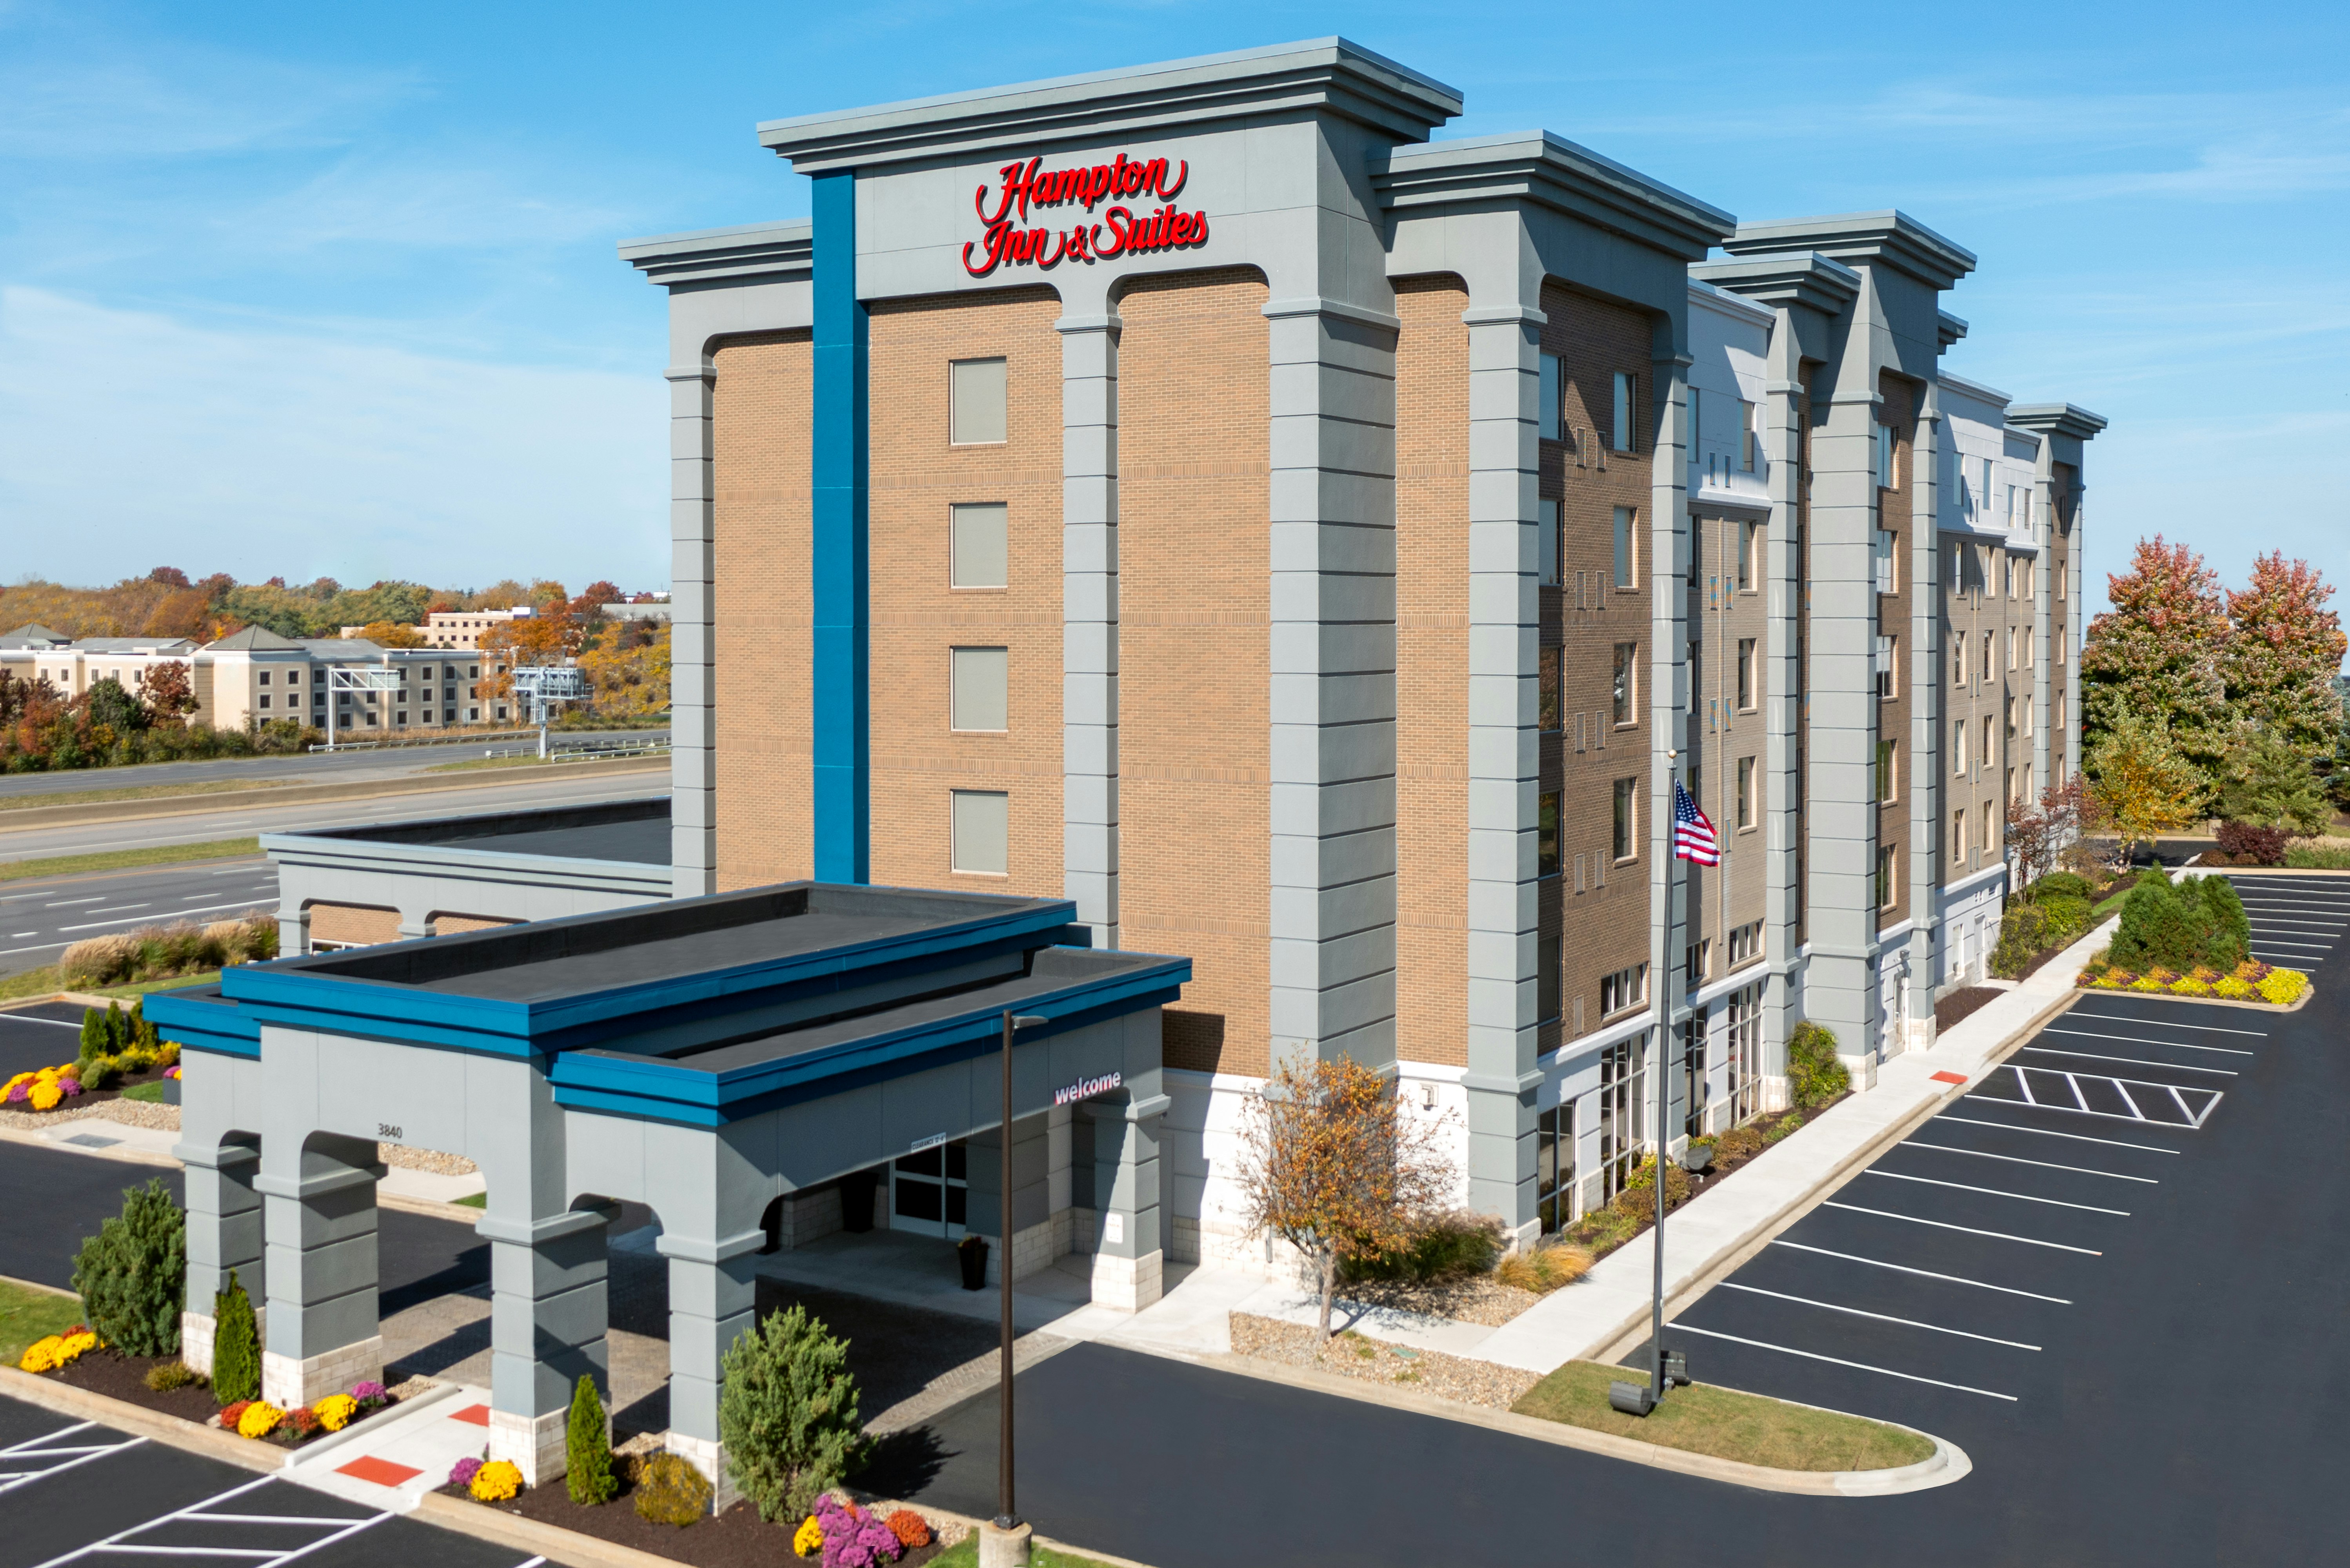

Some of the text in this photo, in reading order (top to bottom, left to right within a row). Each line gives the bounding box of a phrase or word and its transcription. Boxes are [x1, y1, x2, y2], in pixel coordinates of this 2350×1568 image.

[976, 153, 1186, 222] Hampton
[963, 204, 1207, 273] Inn & Suites
[1055, 1071, 1121, 1105] welcome
[378, 1123, 402, 1138] 3840
[912, 1138, 933, 1150] CLEARANCE
